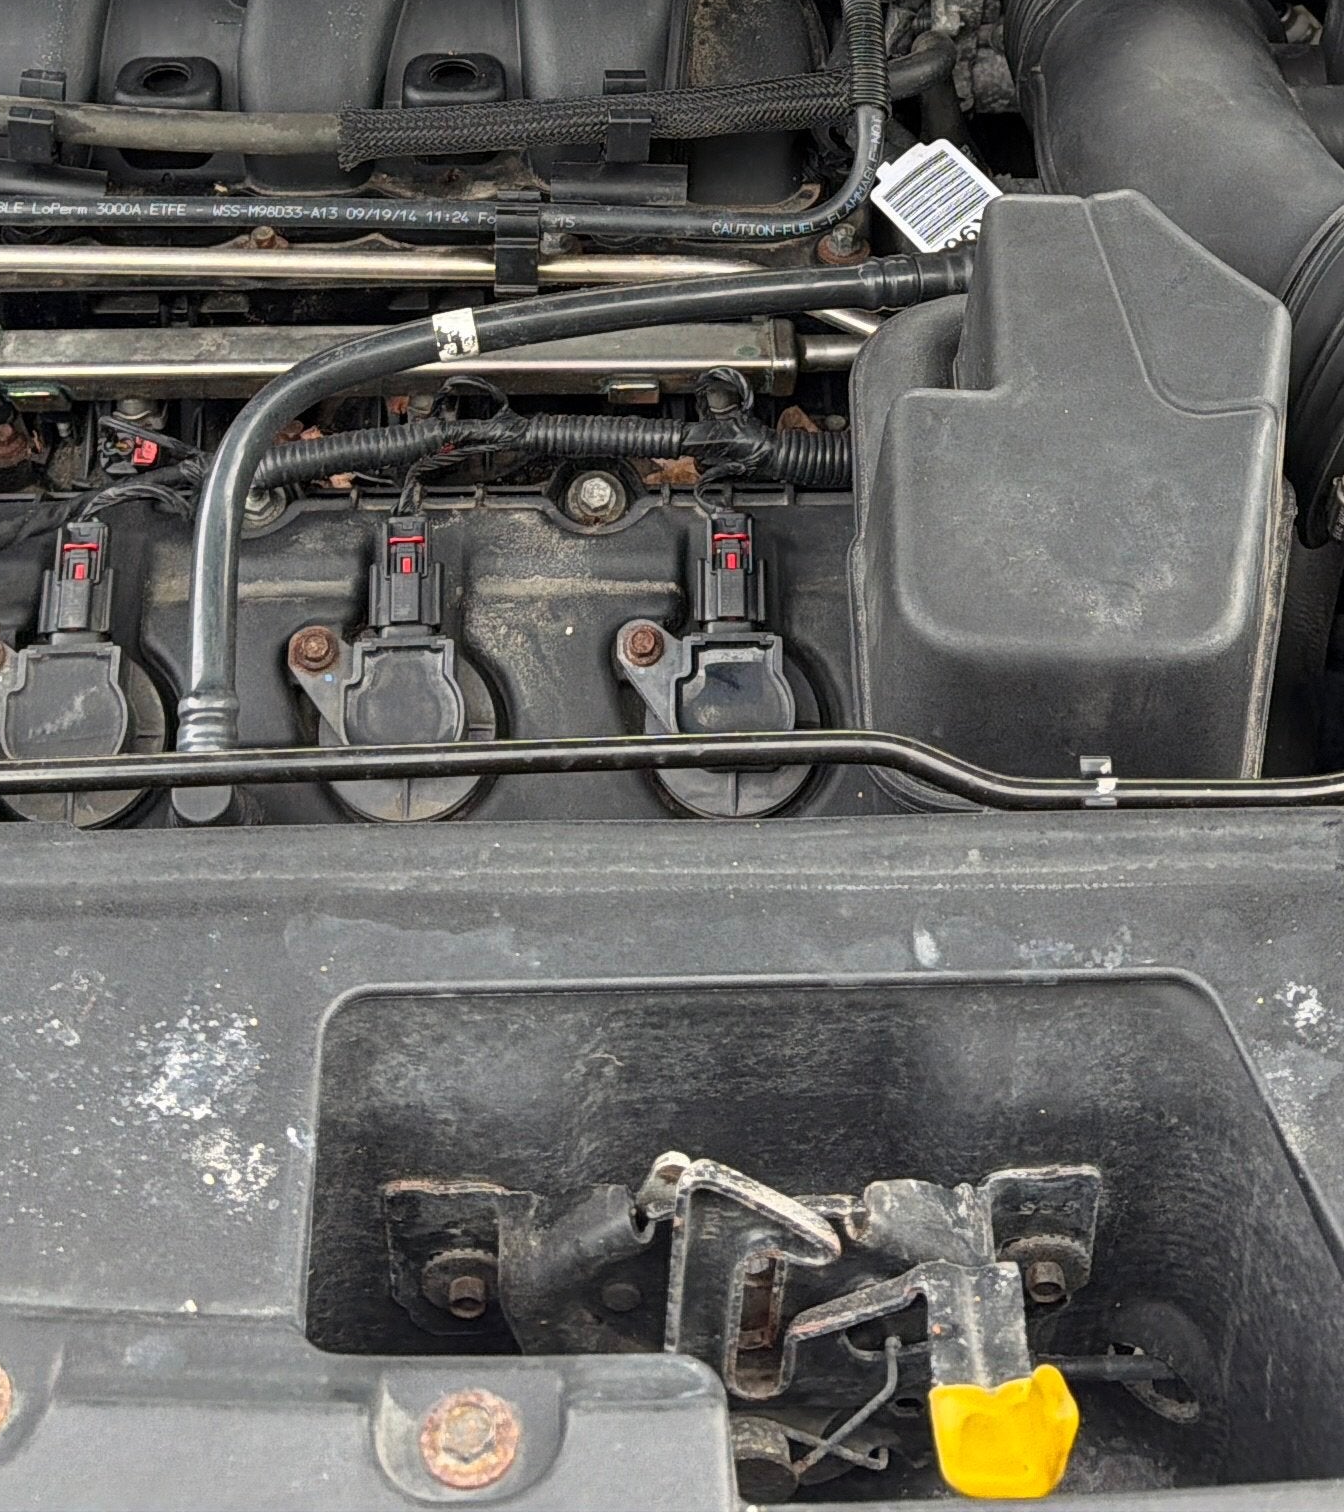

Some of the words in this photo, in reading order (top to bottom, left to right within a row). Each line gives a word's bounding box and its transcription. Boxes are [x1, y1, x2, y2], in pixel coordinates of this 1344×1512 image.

[31, 202, 87, 216] LoPerm
[149, 203, 187, 216] ETFE
[345, 206, 417, 222] 09/19/14
[425, 209, 469, 224] 11:24
